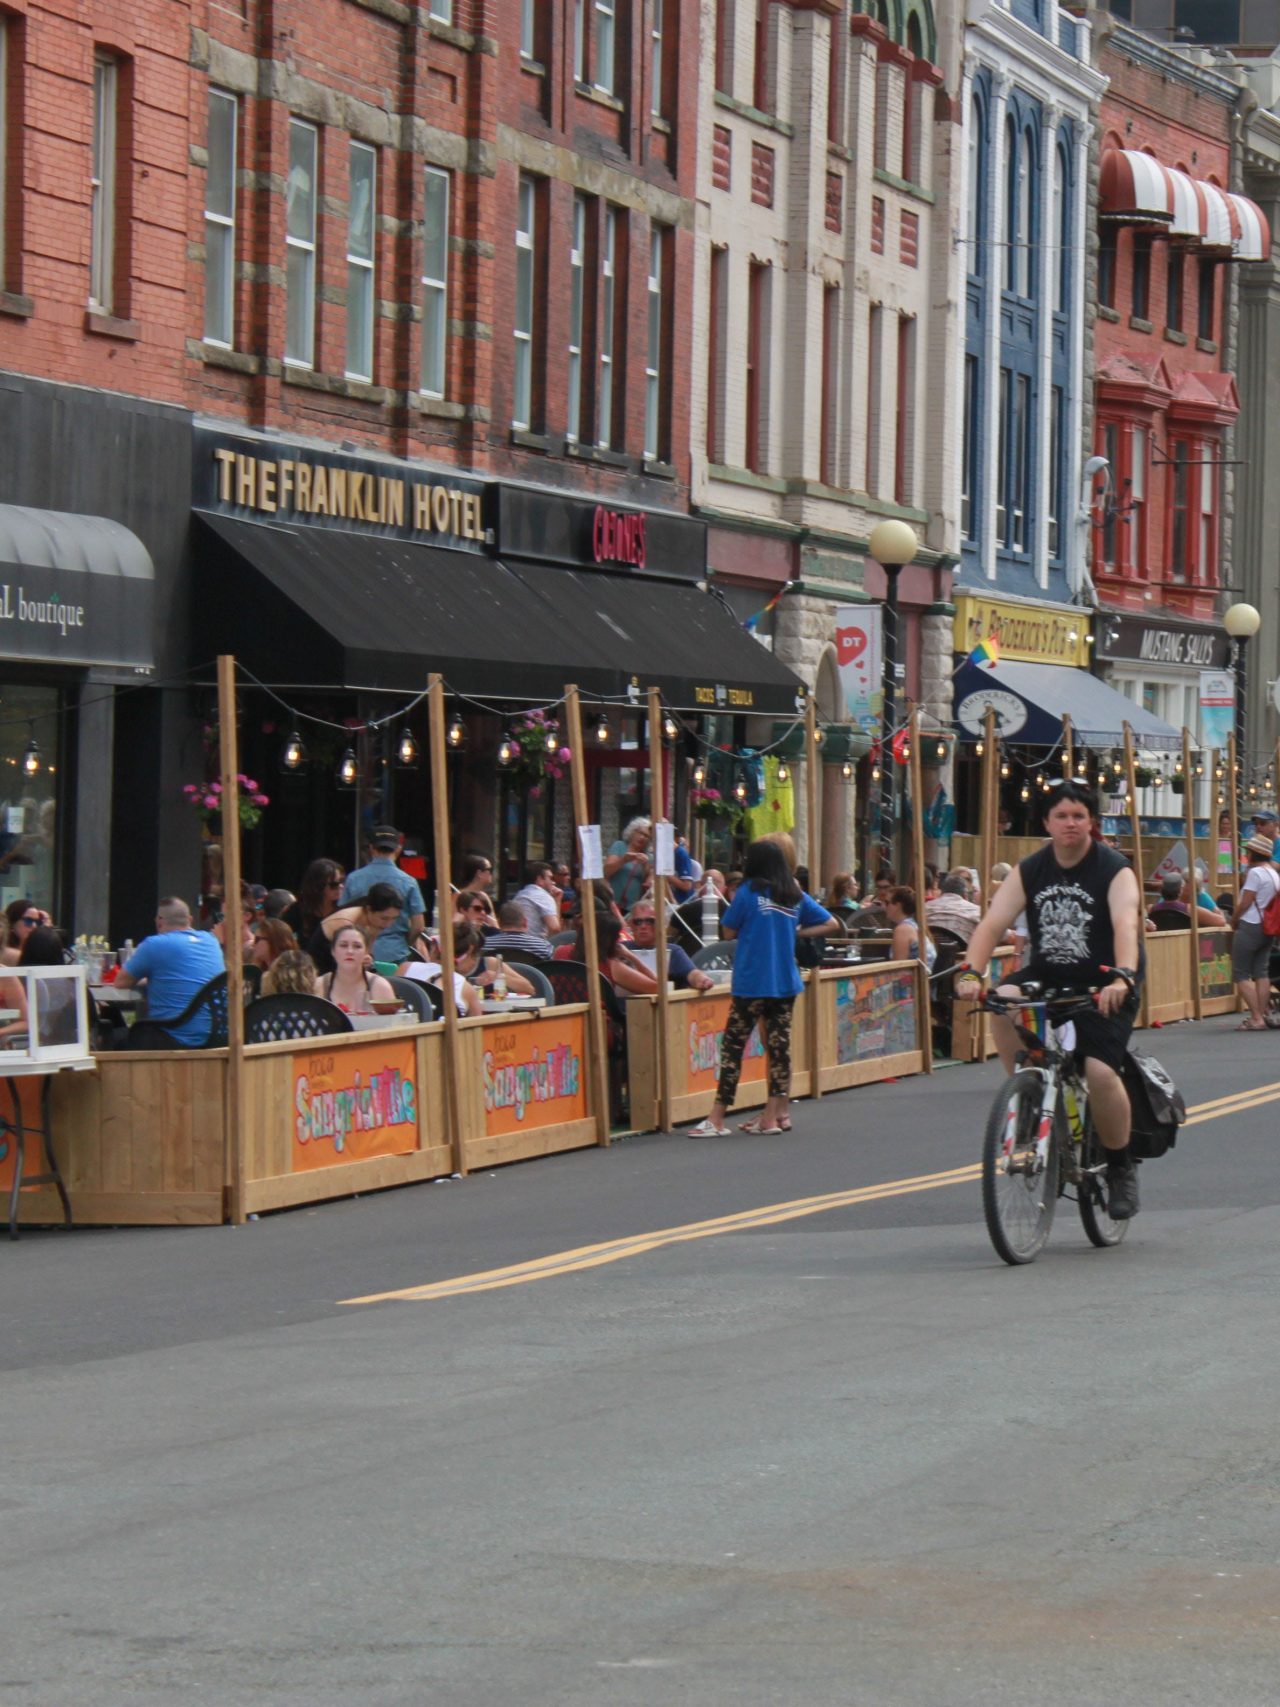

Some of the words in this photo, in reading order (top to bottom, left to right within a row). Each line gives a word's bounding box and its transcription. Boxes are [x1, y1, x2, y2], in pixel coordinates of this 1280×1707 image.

[214, 448, 277, 513] THE
[277, 458, 404, 527] FRANKLIN
[412, 482, 486, 541] HOTEL
[19, 587, 84, 636] boutique
[842, 636, 862, 648] DT
[1140, 628, 1185, 662] MUSTANG
